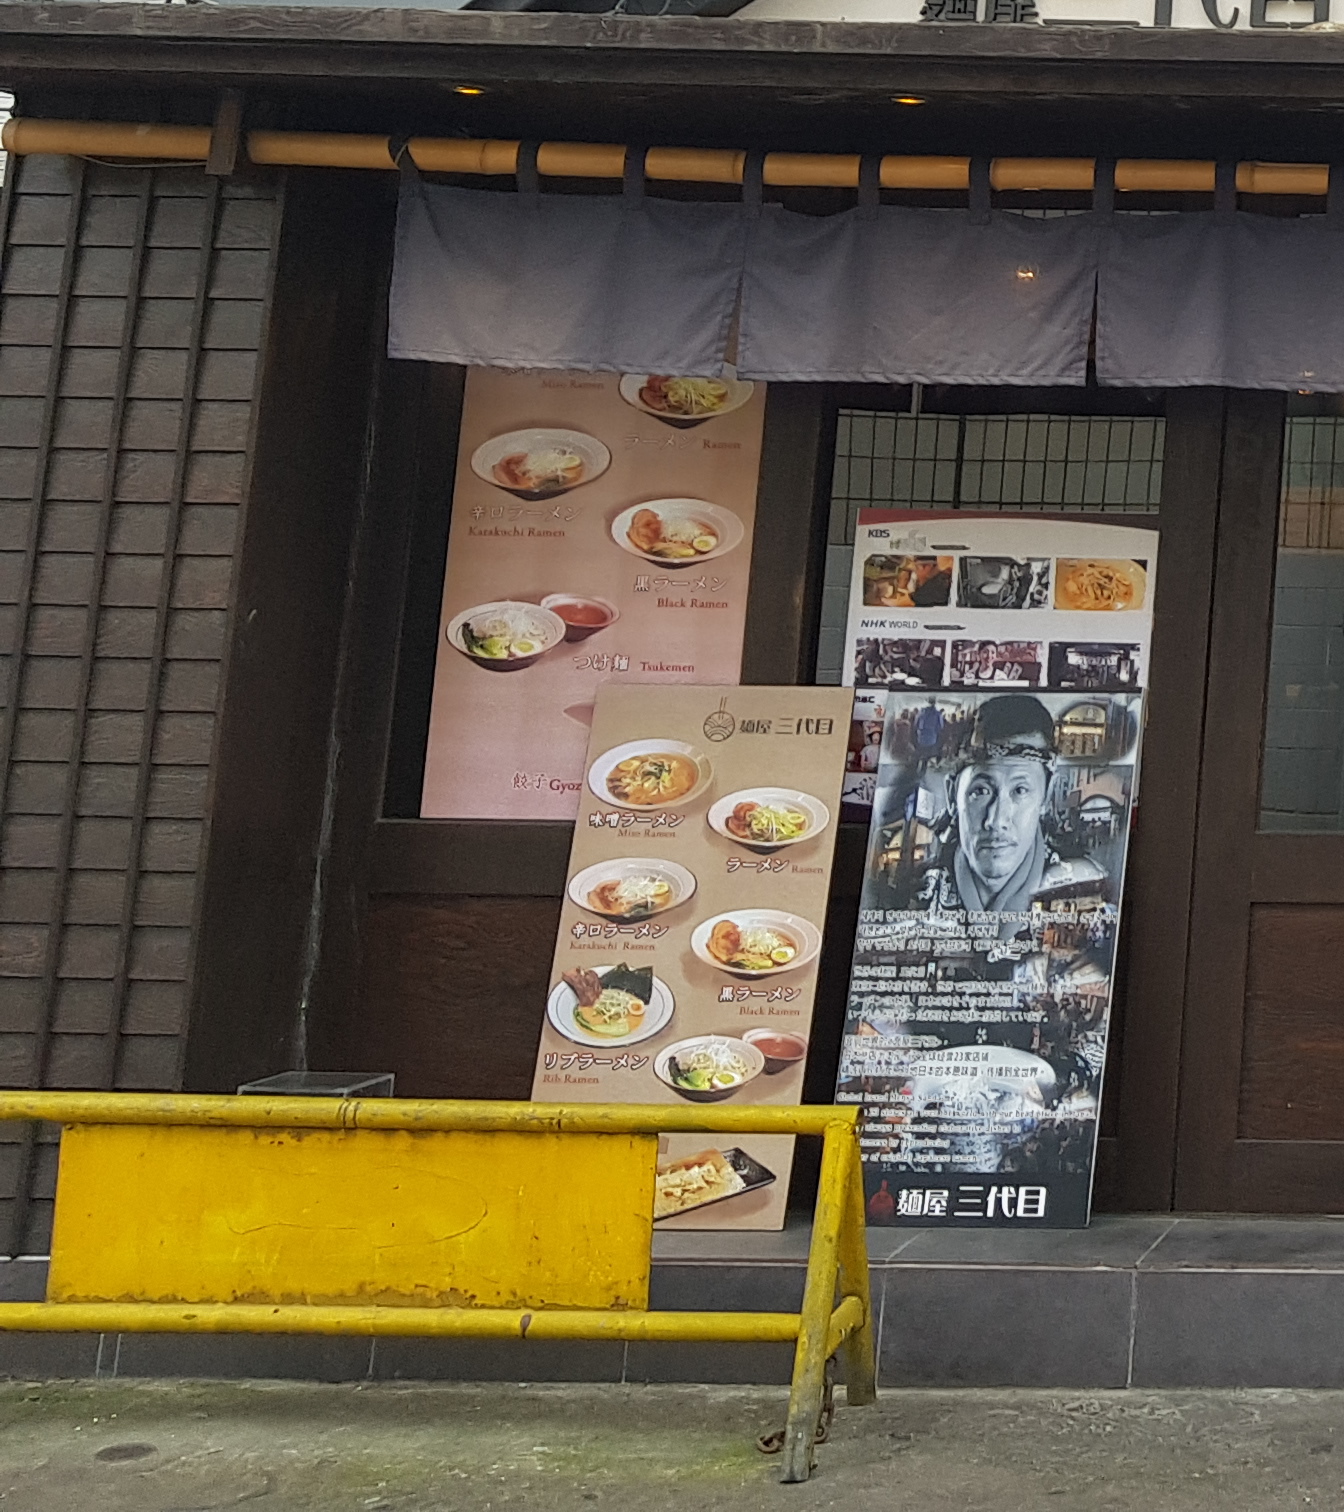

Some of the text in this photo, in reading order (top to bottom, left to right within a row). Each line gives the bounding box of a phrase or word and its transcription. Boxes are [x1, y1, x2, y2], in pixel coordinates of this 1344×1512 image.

[623, 434, 696, 451] ラーメン
[703, 439, 742, 450] Ramen
[470, 505, 583, 522] 辛口ラーメン
[528, 527, 565, 537] Ramen
[633, 574, 728, 593] 黒ラーメン
[657, 598, 728, 609] Black Ramen
[861, 619, 918, 629] NHK WORLD
[573, 654, 630, 673] つけ麺
[640, 661, 695, 673] Tsukemen
[549, 778, 582, 794] Gyoz
[643, 828, 676, 838] Ramen
[727, 857, 789, 874] ラーメン
[791, 864, 824, 875] Ramen
[572, 921, 670, 940] 辛口ラーメン
[623, 941, 656, 951] Ramen
[718, 985, 802, 1003] 黒ラーメン
[739, 1005, 800, 1017] Black Ramen
[543, 1052, 650, 1071] リブラーメン
[543, 1074, 599, 1085] Rib Ramen
